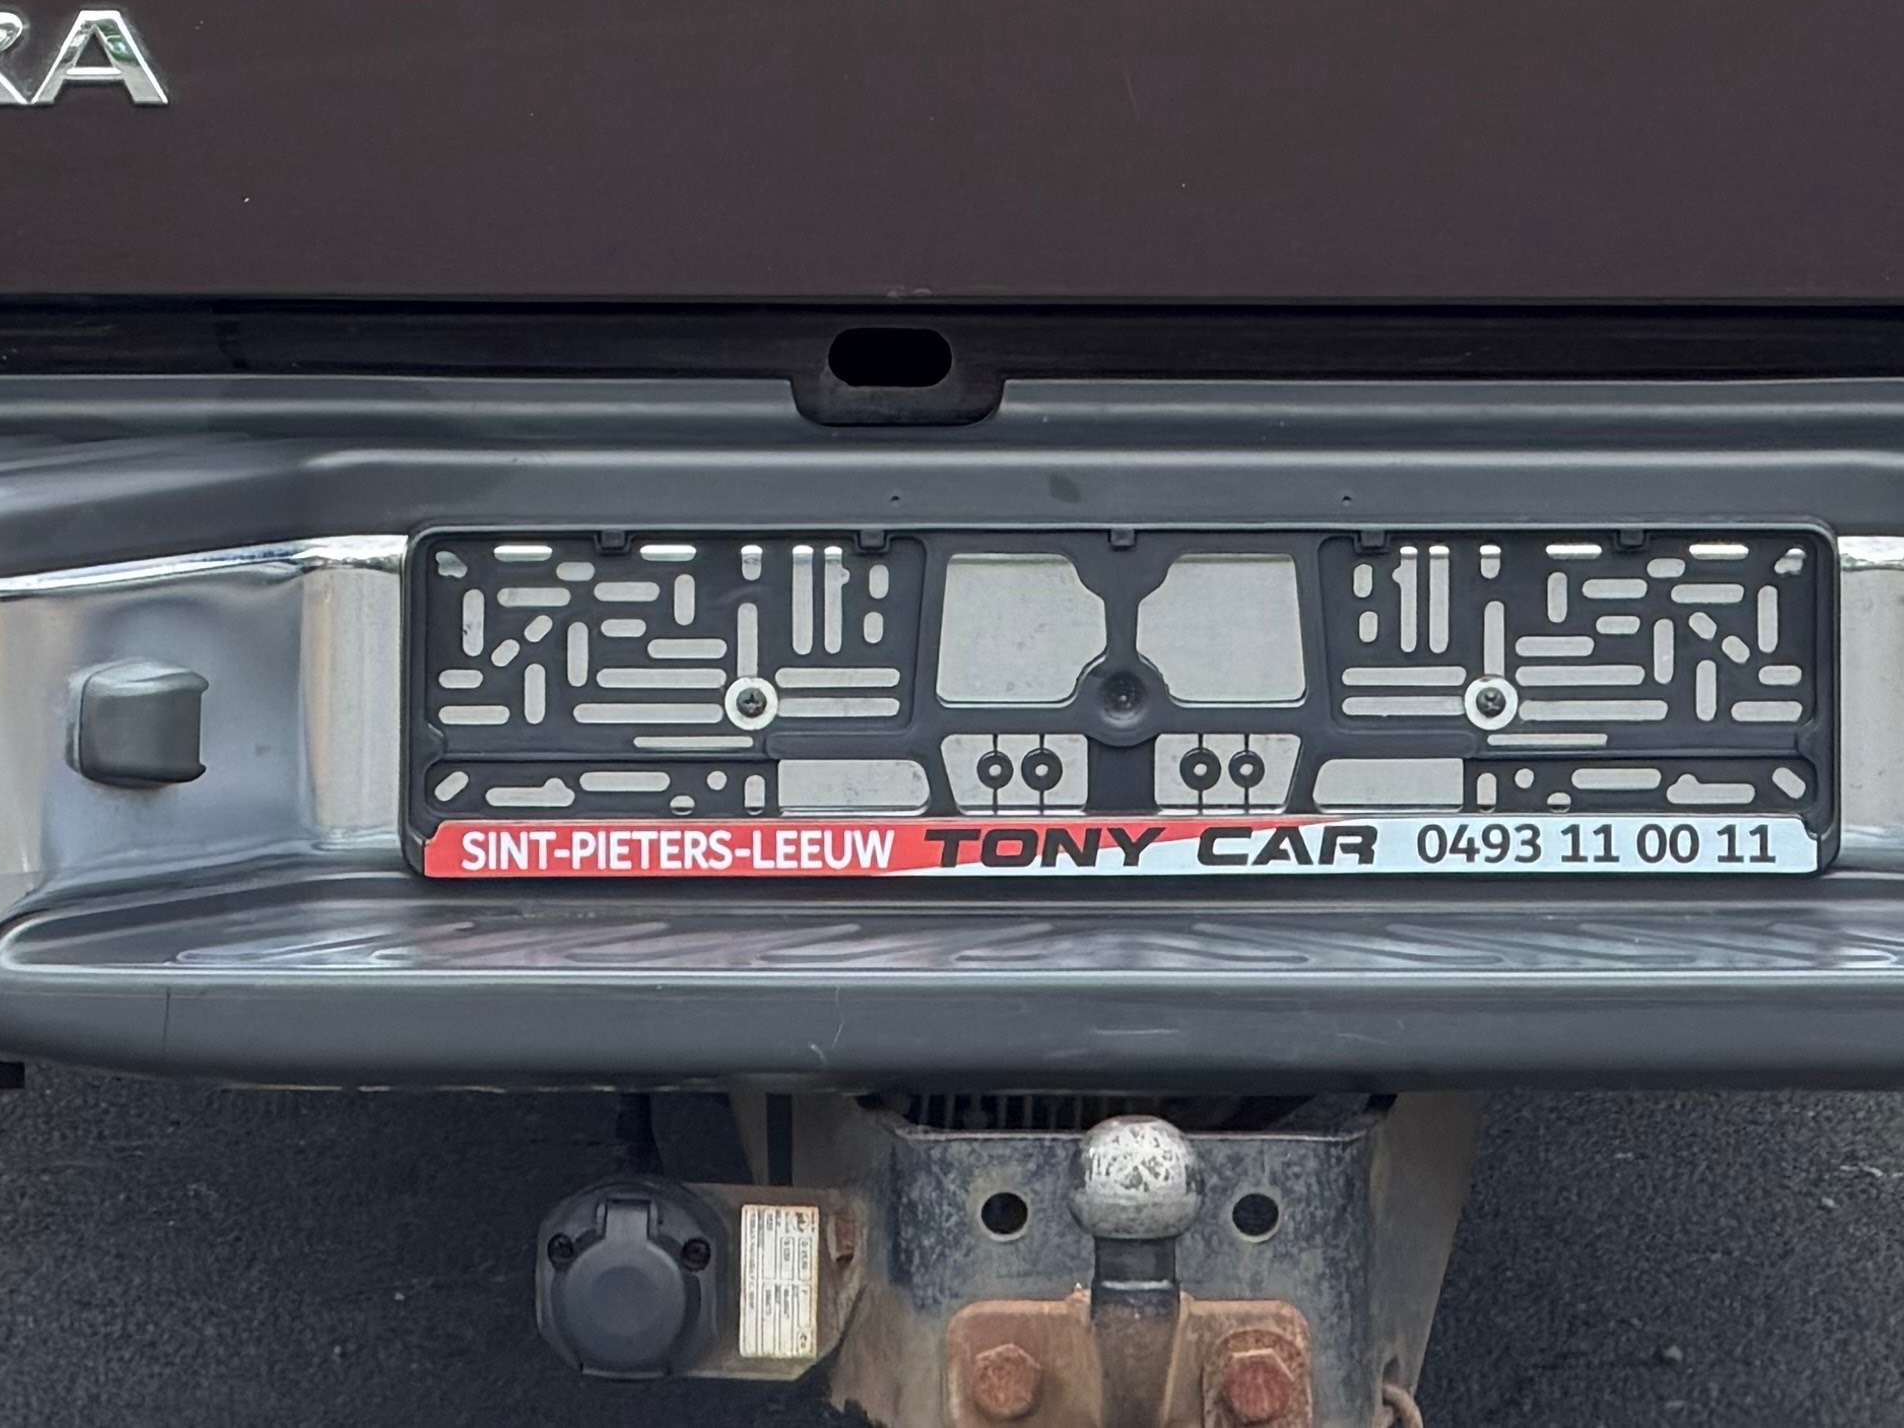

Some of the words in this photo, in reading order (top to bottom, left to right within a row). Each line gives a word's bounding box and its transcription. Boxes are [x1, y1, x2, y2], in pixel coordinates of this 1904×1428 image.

[461, 828, 895, 871] SINT-PIETERS-LEEUW
[924, 826, 1164, 869] TONY
[1196, 825, 1379, 866] CAR
[1416, 823, 1542, 864] 0493
[1560, 823, 1619, 863] 11
[1636, 823, 1700, 864] 00
[1716, 823, 1777, 863] 11
